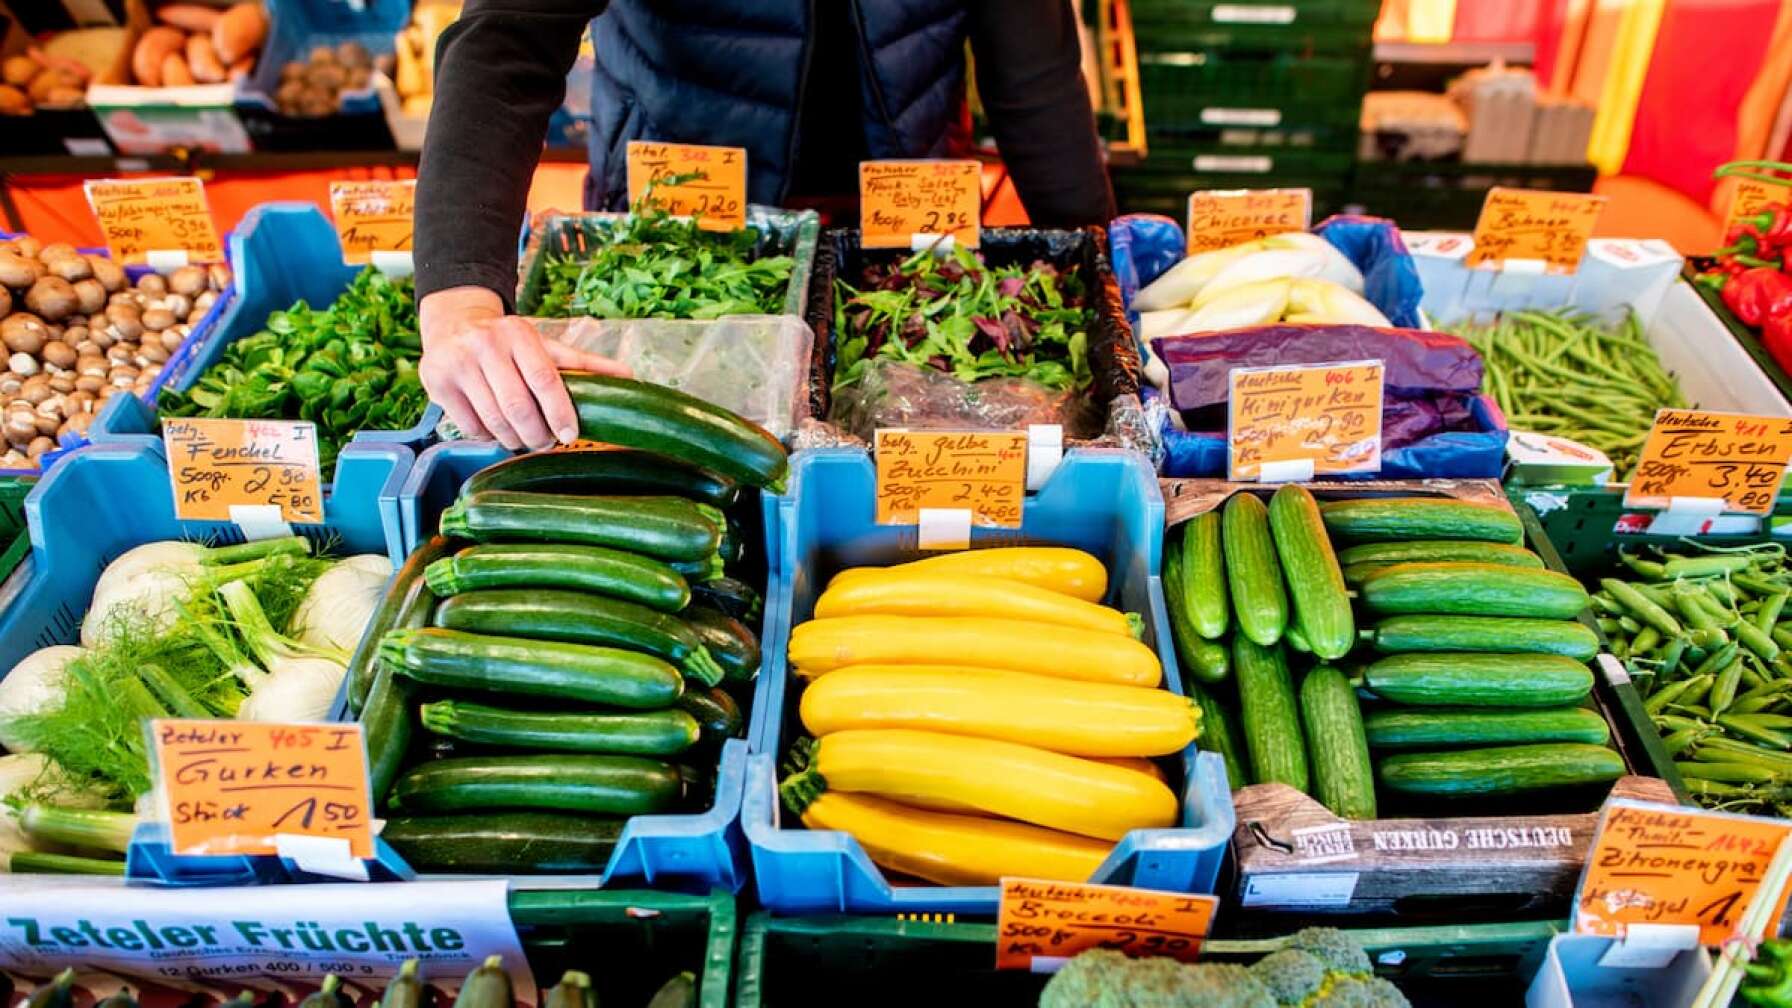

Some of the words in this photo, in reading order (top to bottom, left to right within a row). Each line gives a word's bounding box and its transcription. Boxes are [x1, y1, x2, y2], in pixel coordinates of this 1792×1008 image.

[1324, 371, 1354, 387] 406
[925, 434, 990, 466] gelbe
[1660, 433, 1778, 460] Erbsen
[161, 726, 244, 747] Zeteler
[270, 727, 321, 750] 405
[175, 758, 329, 786] Gurken
[1372, 827, 1461, 852] GURKEN
[1465, 825, 1575, 850] DEUTSCHE
[7, 916, 219, 951] Zeteler
[231, 920, 466, 953] Früchte
[157, 966, 181, 978] 12
[184, 961, 262, 980] Gurken
[265, 960, 302, 974] 400
[318, 961, 356, 974] 500
[359, 963, 375, 976] g
